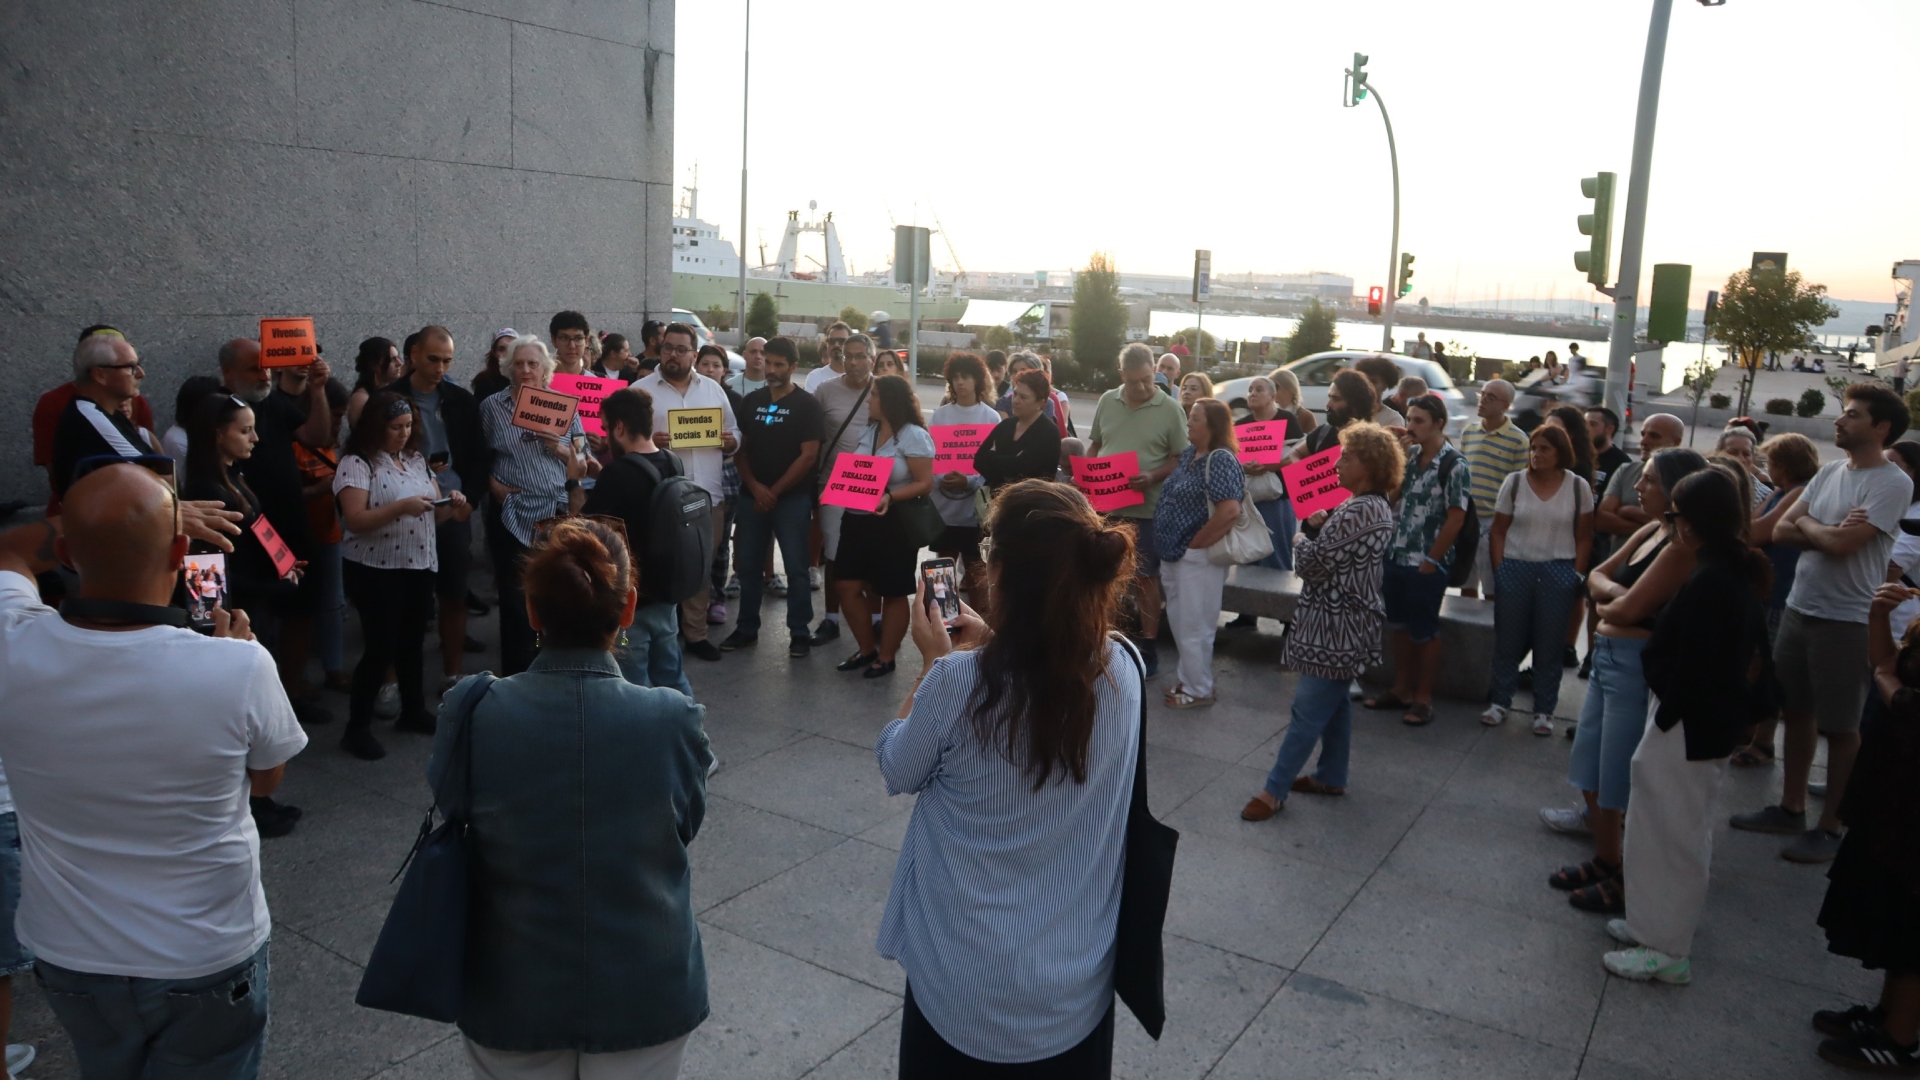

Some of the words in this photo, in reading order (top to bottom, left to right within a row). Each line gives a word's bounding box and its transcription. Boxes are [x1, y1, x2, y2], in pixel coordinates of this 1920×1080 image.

[271, 328, 307, 339] Vivendas
[266, 346, 297, 357] sociais
[575, 381, 603, 391] QUEN
[530, 395, 568, 412] Vivendas
[519, 410, 551, 426] sociais
[554, 417, 568, 428] Xa!
[677, 415, 713, 425] Vivendas
[673, 431, 702, 440] sociais
[705, 429, 718, 439] Xa!
[953, 429, 977, 438] QUEN
[1246, 425, 1266, 433] QUEN
[942, 441, 981, 449] DESALOX
[1245, 445, 1278, 453] REALOXE
[935, 453, 952, 461] QUE
[853, 460, 874, 468] QUEN
[1087, 461, 1111, 472] QUEN
[1306, 456, 1330, 471] QUEN
[841, 471, 877, 482] DESALOXA
[1082, 472, 1125, 482] DESALOXA
[1299, 467, 1338, 487] DESALOX
[830, 483, 845, 491] QUE
[847, 485, 880, 496] REALOXE
[1094, 483, 1132, 496] REALOX
[1296, 491, 1314, 503] QUE
